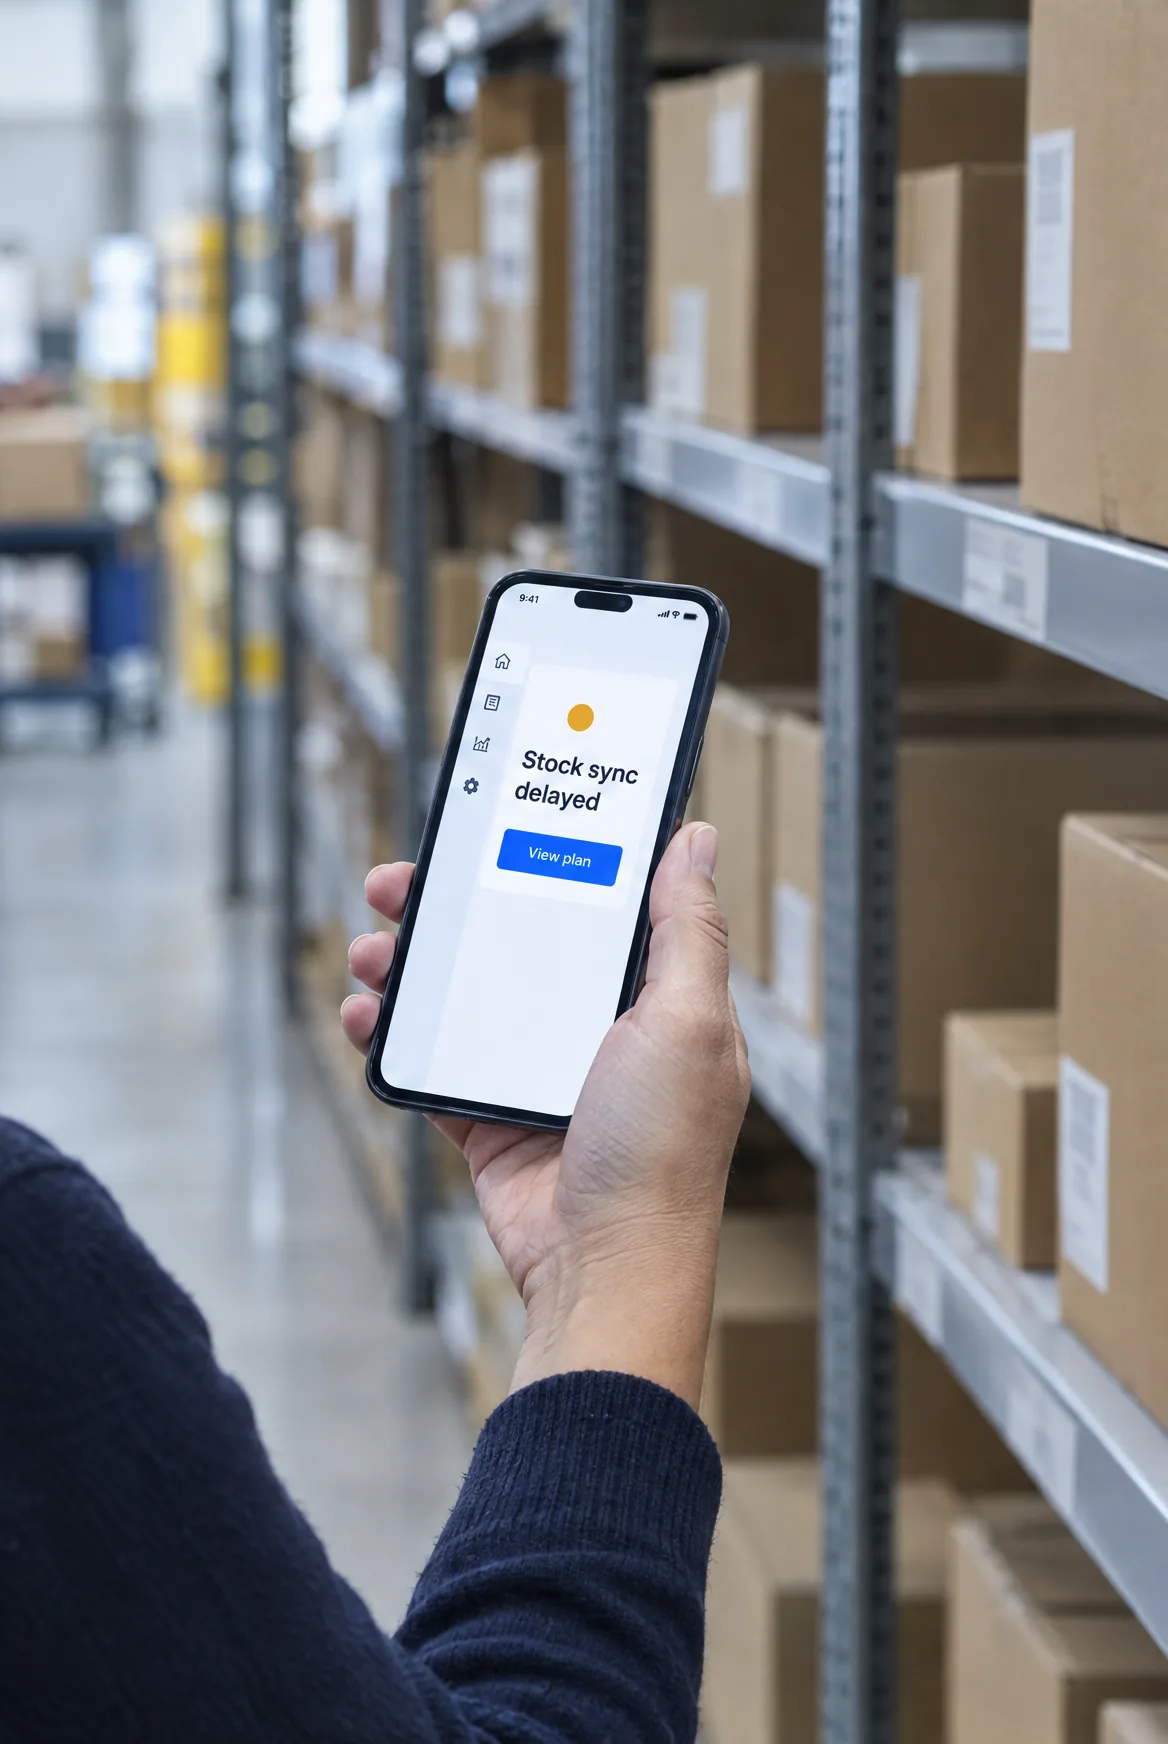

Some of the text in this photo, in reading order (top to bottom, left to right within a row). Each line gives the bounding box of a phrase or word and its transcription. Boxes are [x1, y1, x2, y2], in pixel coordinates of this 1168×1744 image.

[519, 594, 539, 604] 9:41
[522, 750, 638, 786] Stock sync
[515, 782, 601, 811] delayed
[528, 846, 591, 869] View plan
